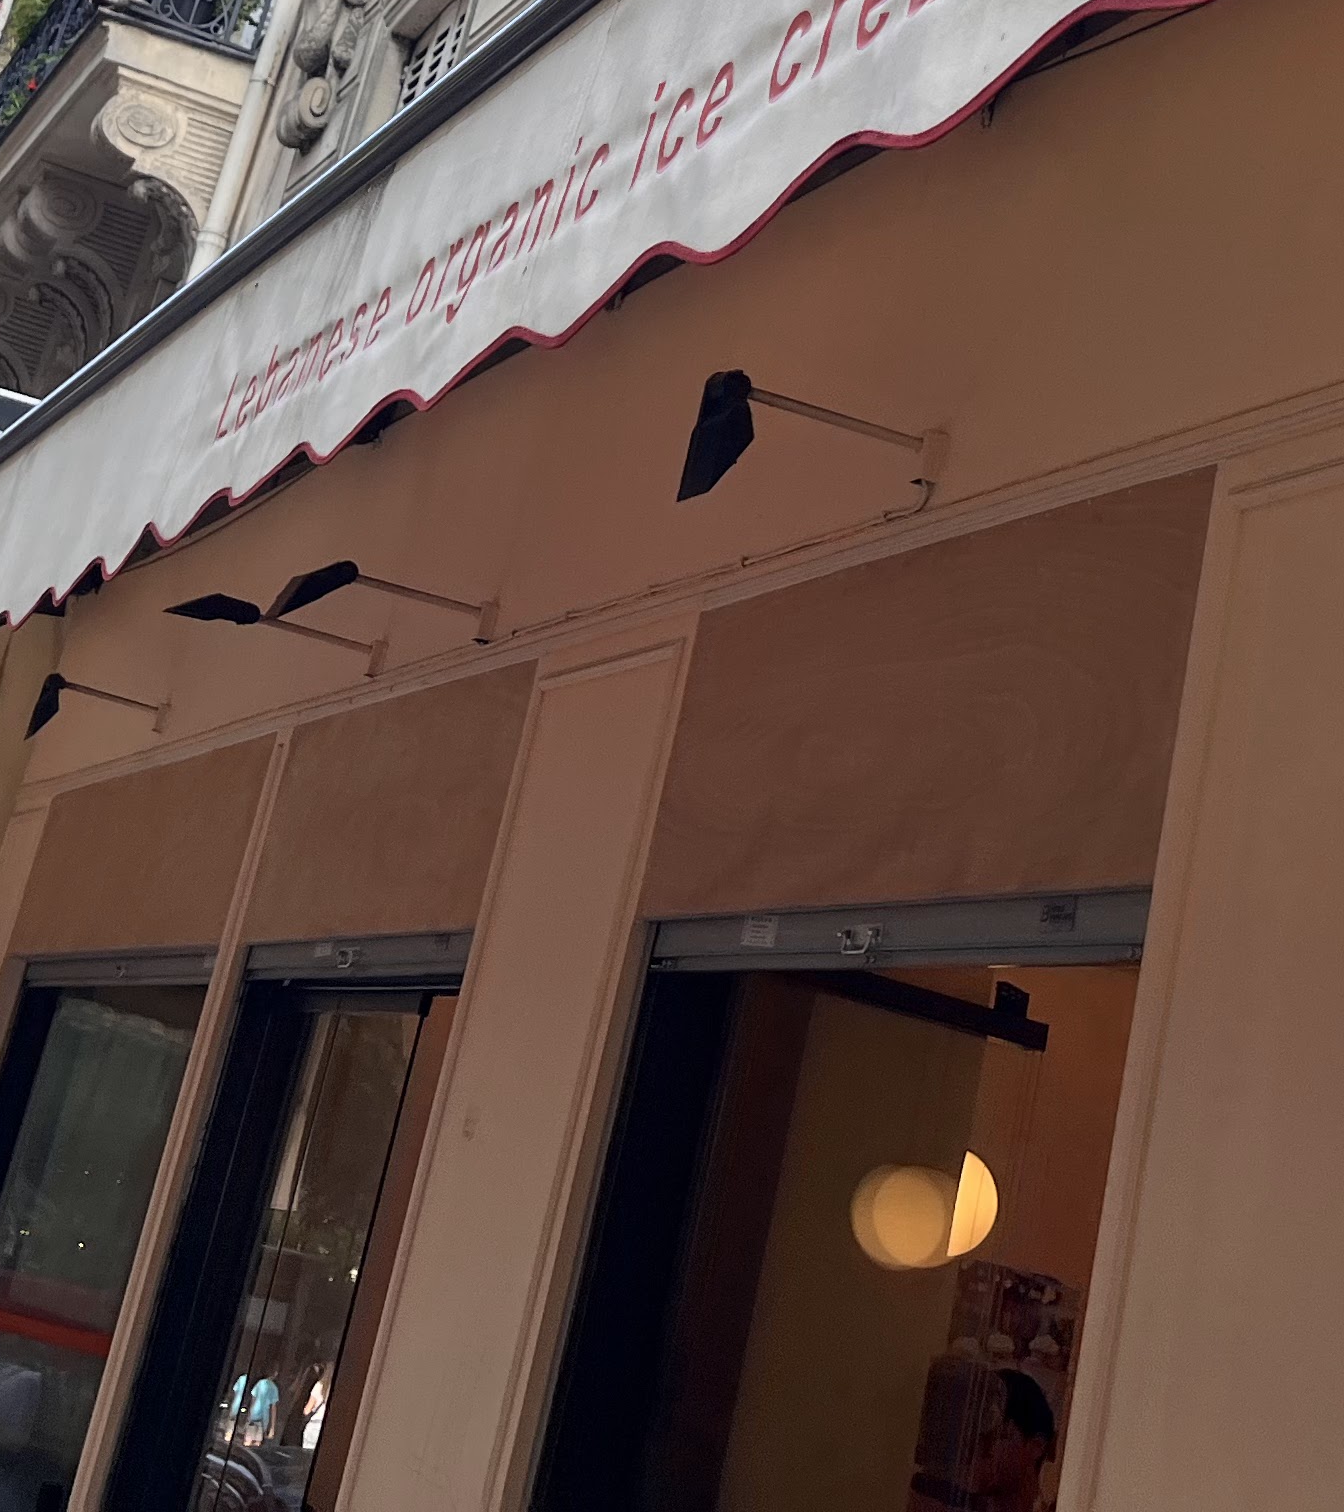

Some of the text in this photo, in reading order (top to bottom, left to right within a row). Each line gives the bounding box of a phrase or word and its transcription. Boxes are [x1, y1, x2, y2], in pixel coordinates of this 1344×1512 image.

[215, 286, 392, 441] Lebanese
[404, 138, 611, 325] organic
[630, 60, 736, 190] ice
